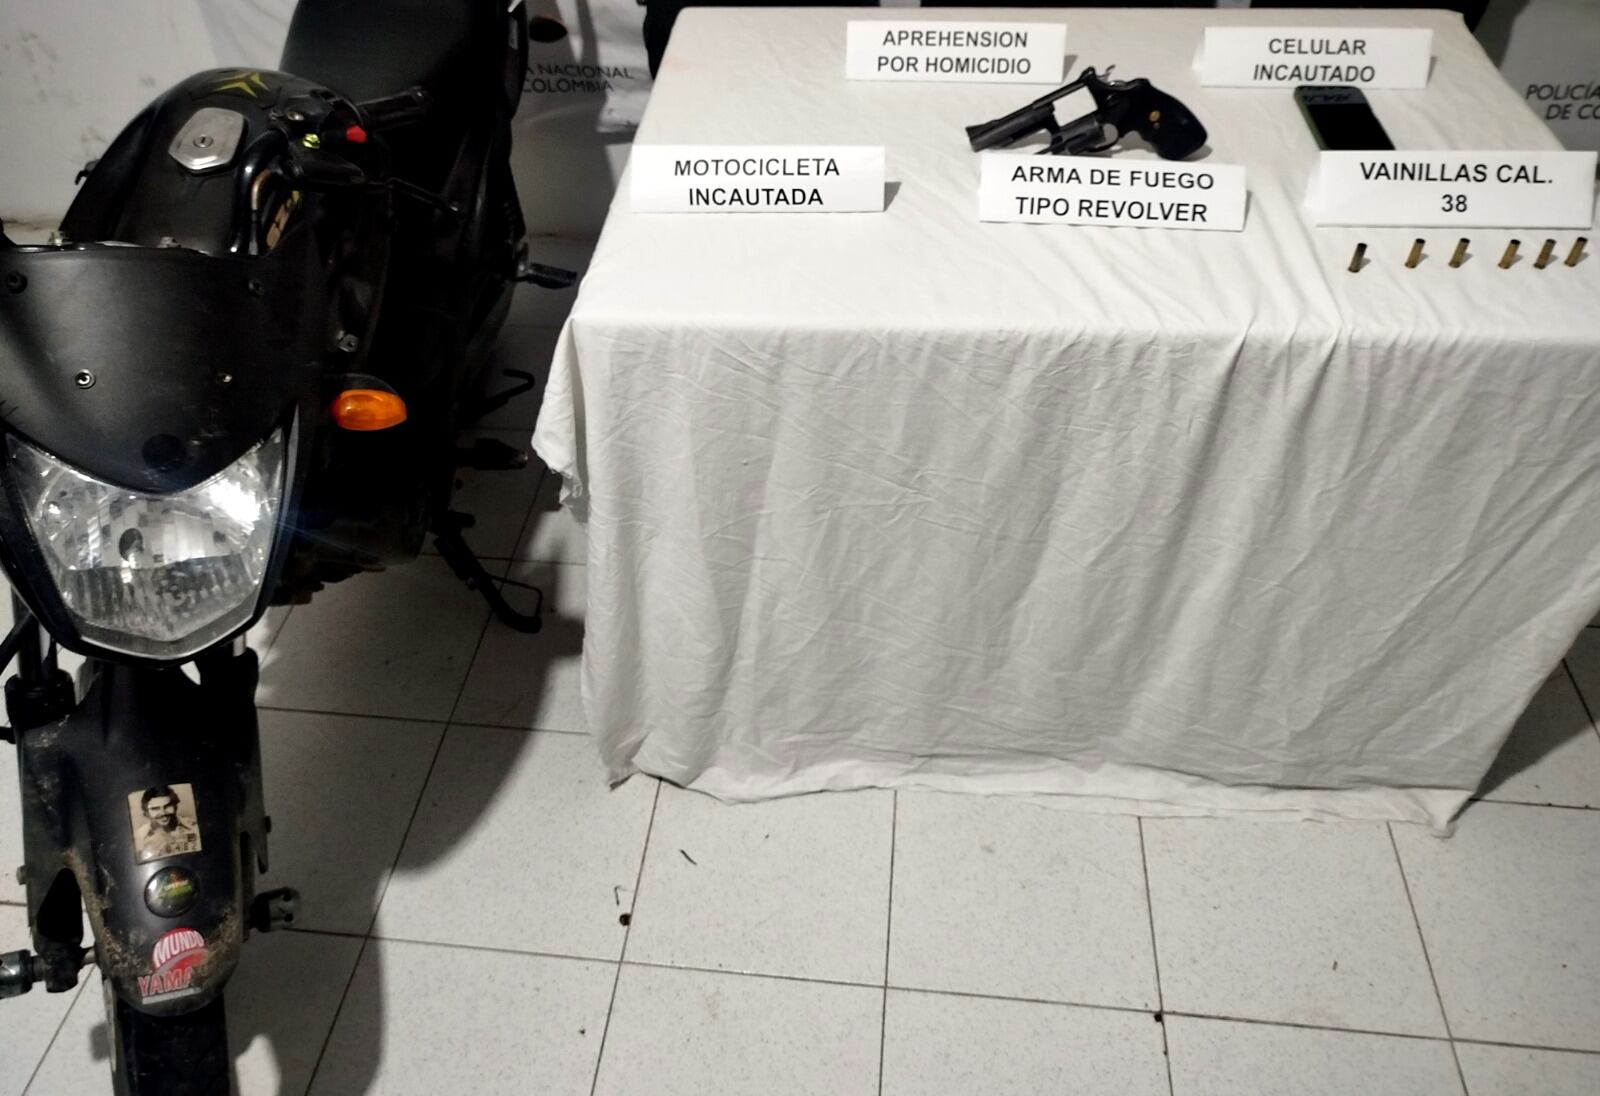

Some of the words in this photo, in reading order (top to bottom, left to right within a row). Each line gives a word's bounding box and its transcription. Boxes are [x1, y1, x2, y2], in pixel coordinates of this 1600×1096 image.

[883, 30, 1028, 48] APREHENSION
[1268, 38, 1366, 55] CELULAR
[536, 63, 635, 80] NACIONAL
[877, 56, 919, 72] POR
[925, 57, 1032, 75] HOMICIDIO
[1253, 64, 1376, 82] INCAUTADO
[1545, 103, 1573, 120] DE
[674, 158, 840, 176] MOTOCICLETA
[1360, 162, 1488, 183] VAINILLAS
[1496, 164, 1553, 184] CAL.
[1011, 165, 1082, 185] ARMA
[1090, 168, 1121, 186] DE
[1130, 170, 1214, 190] FUEGO
[689, 187, 824, 206] INCAUTADA
[1441, 193, 1468, 213] 38
[1015, 196, 1070, 216] TIPO
[1078, 199, 1208, 222] REVOLVER
